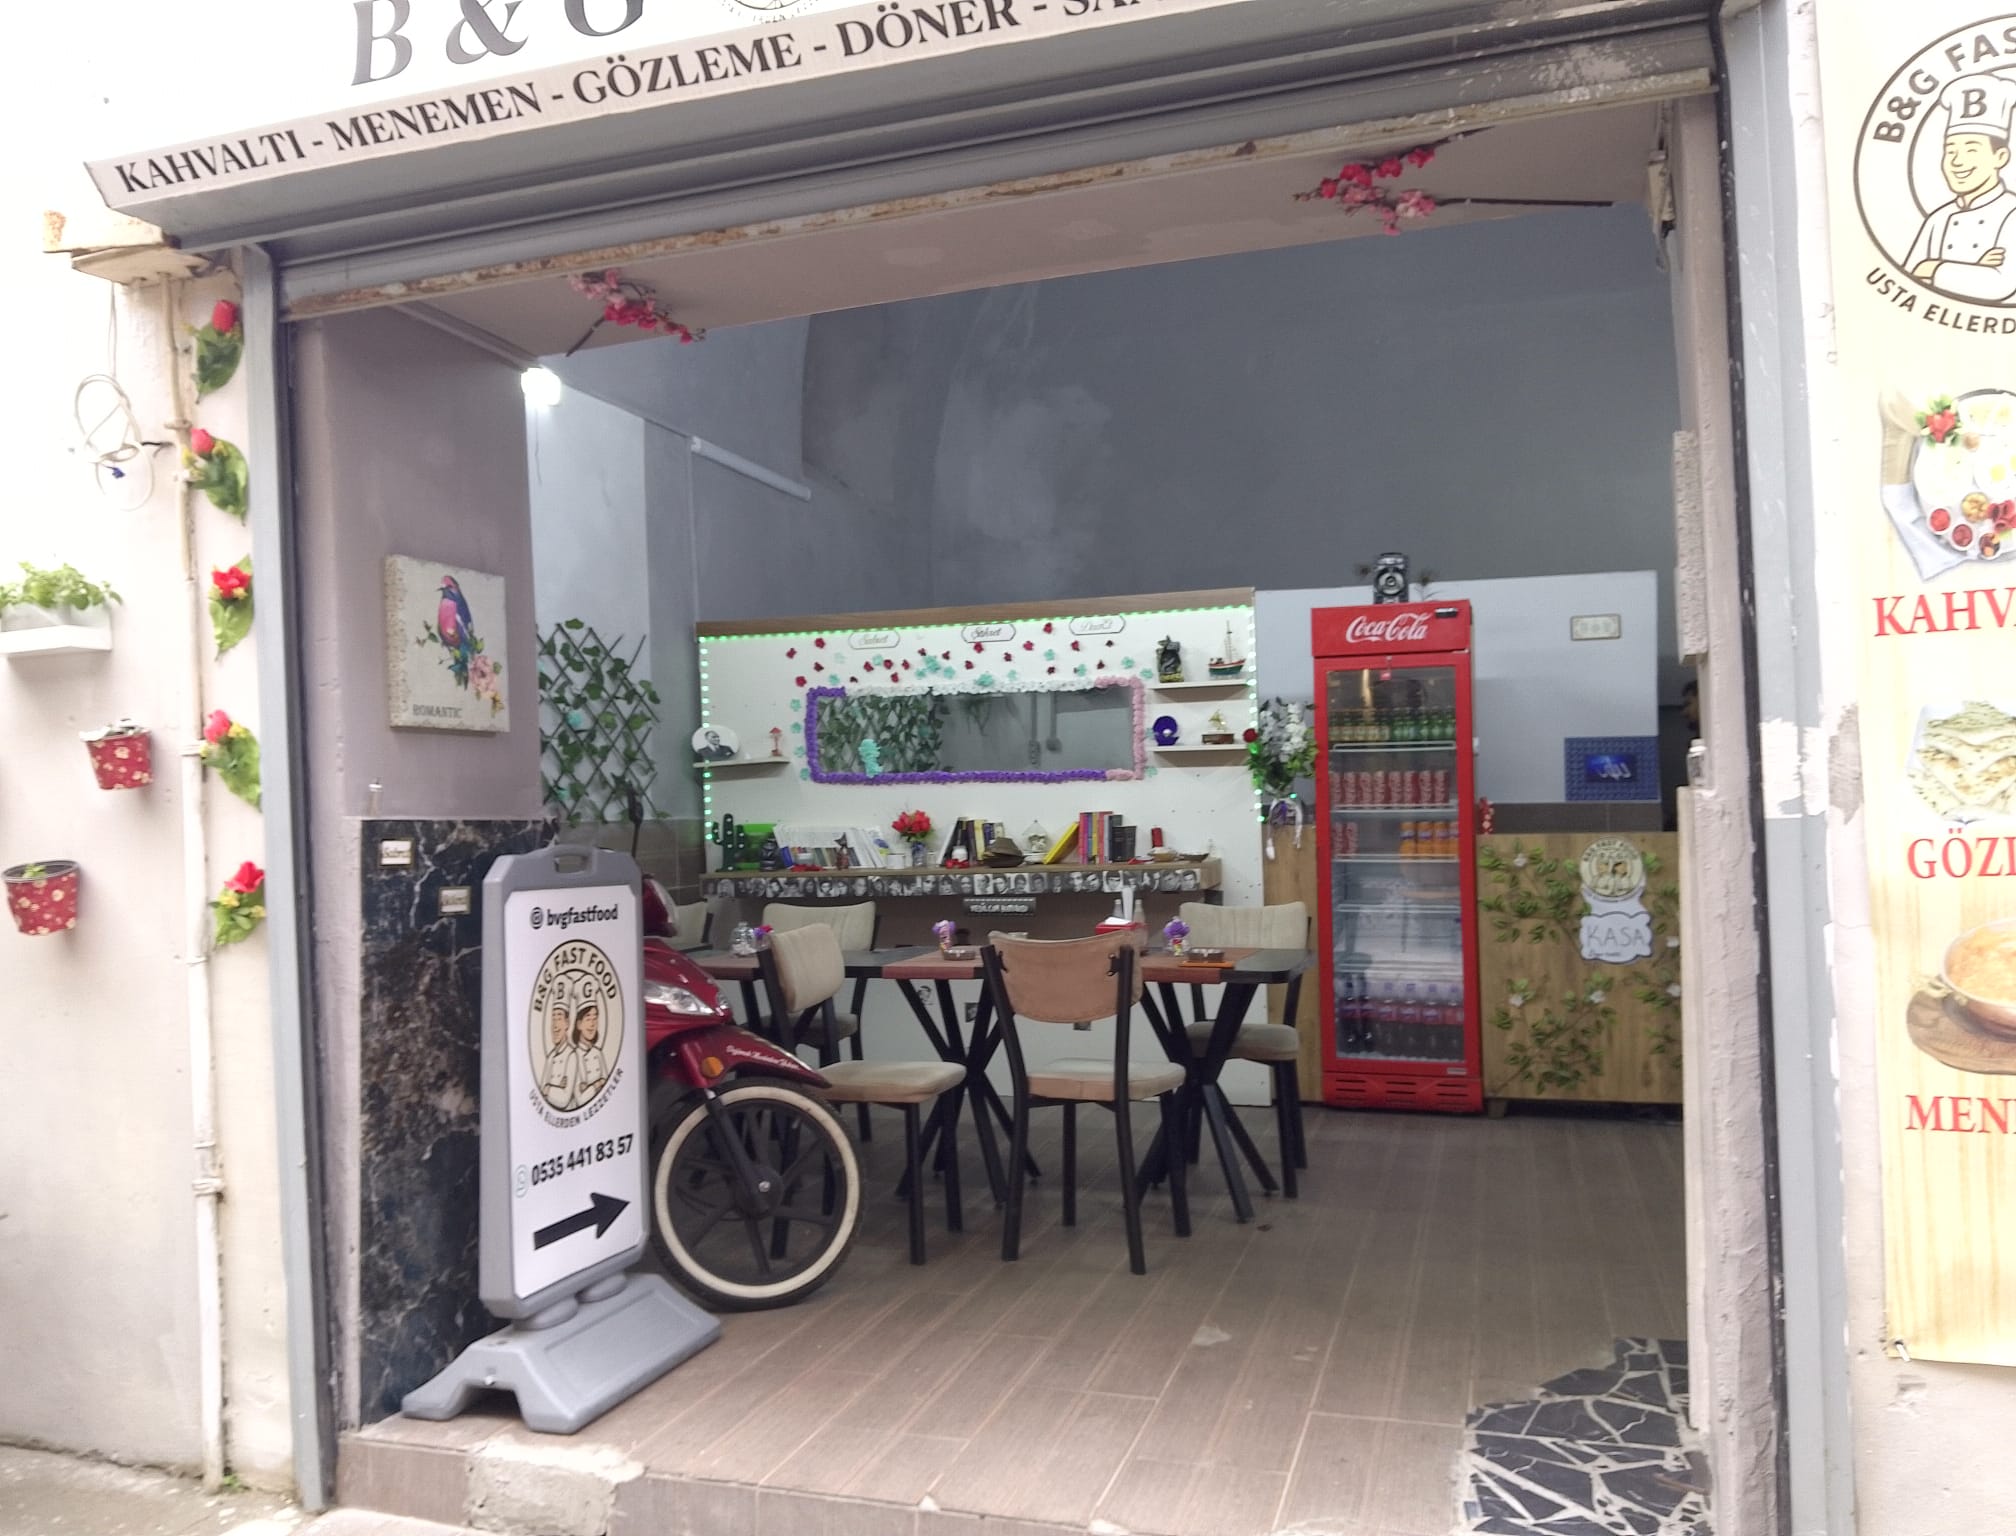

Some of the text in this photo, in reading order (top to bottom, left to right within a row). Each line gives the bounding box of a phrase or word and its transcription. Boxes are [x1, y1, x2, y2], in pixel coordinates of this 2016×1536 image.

[351, 0, 413, 87] B
[446, 0, 529, 65] &
[114, 130, 306, 193] KAHVALTI
[326, 82, 543, 153] MENEMEN
[572, 32, 803, 104] GÖZLEME
[836, 0, 1021, 58] DÖNER
[1872, 68, 1940, 144] B&G
[1959, 87, 1988, 119] B
[1865, 266, 2016, 335] USTA ELLERD
[1345, 612, 1433, 644] Coca-Cola
[1872, 587, 2016, 637] KAHV
[547, 904, 619, 930] bvgfastfood
[1586, 924, 1645, 948] KASA
[553, 946, 587, 972] FAST
[587, 953, 618, 1000] FOOD
[555, 981, 593, 1000] B G
[1905, 1094, 2016, 1135] MEN
[531, 1132, 634, 1187] 0535 441 83 57
